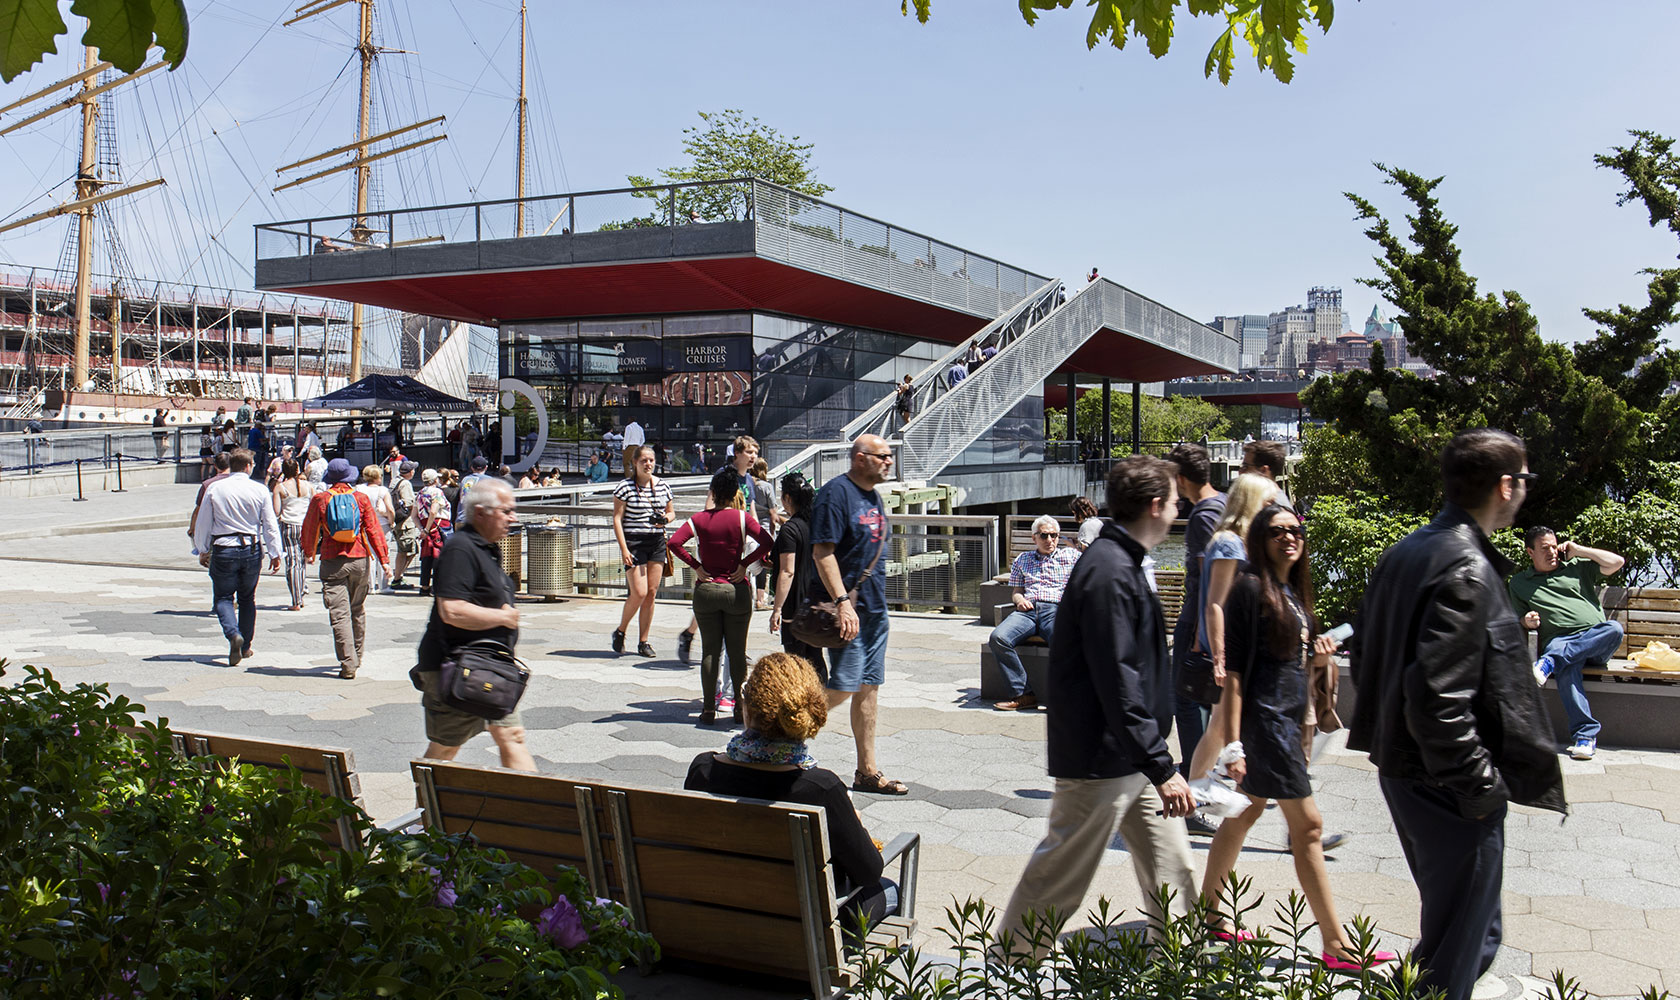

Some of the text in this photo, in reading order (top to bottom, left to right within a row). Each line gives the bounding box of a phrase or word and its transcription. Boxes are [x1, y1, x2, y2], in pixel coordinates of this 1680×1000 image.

[686, 345, 728, 355] HARBOR
[519, 351, 557, 360] HAOR
[686, 354, 727, 364] CRUISES
